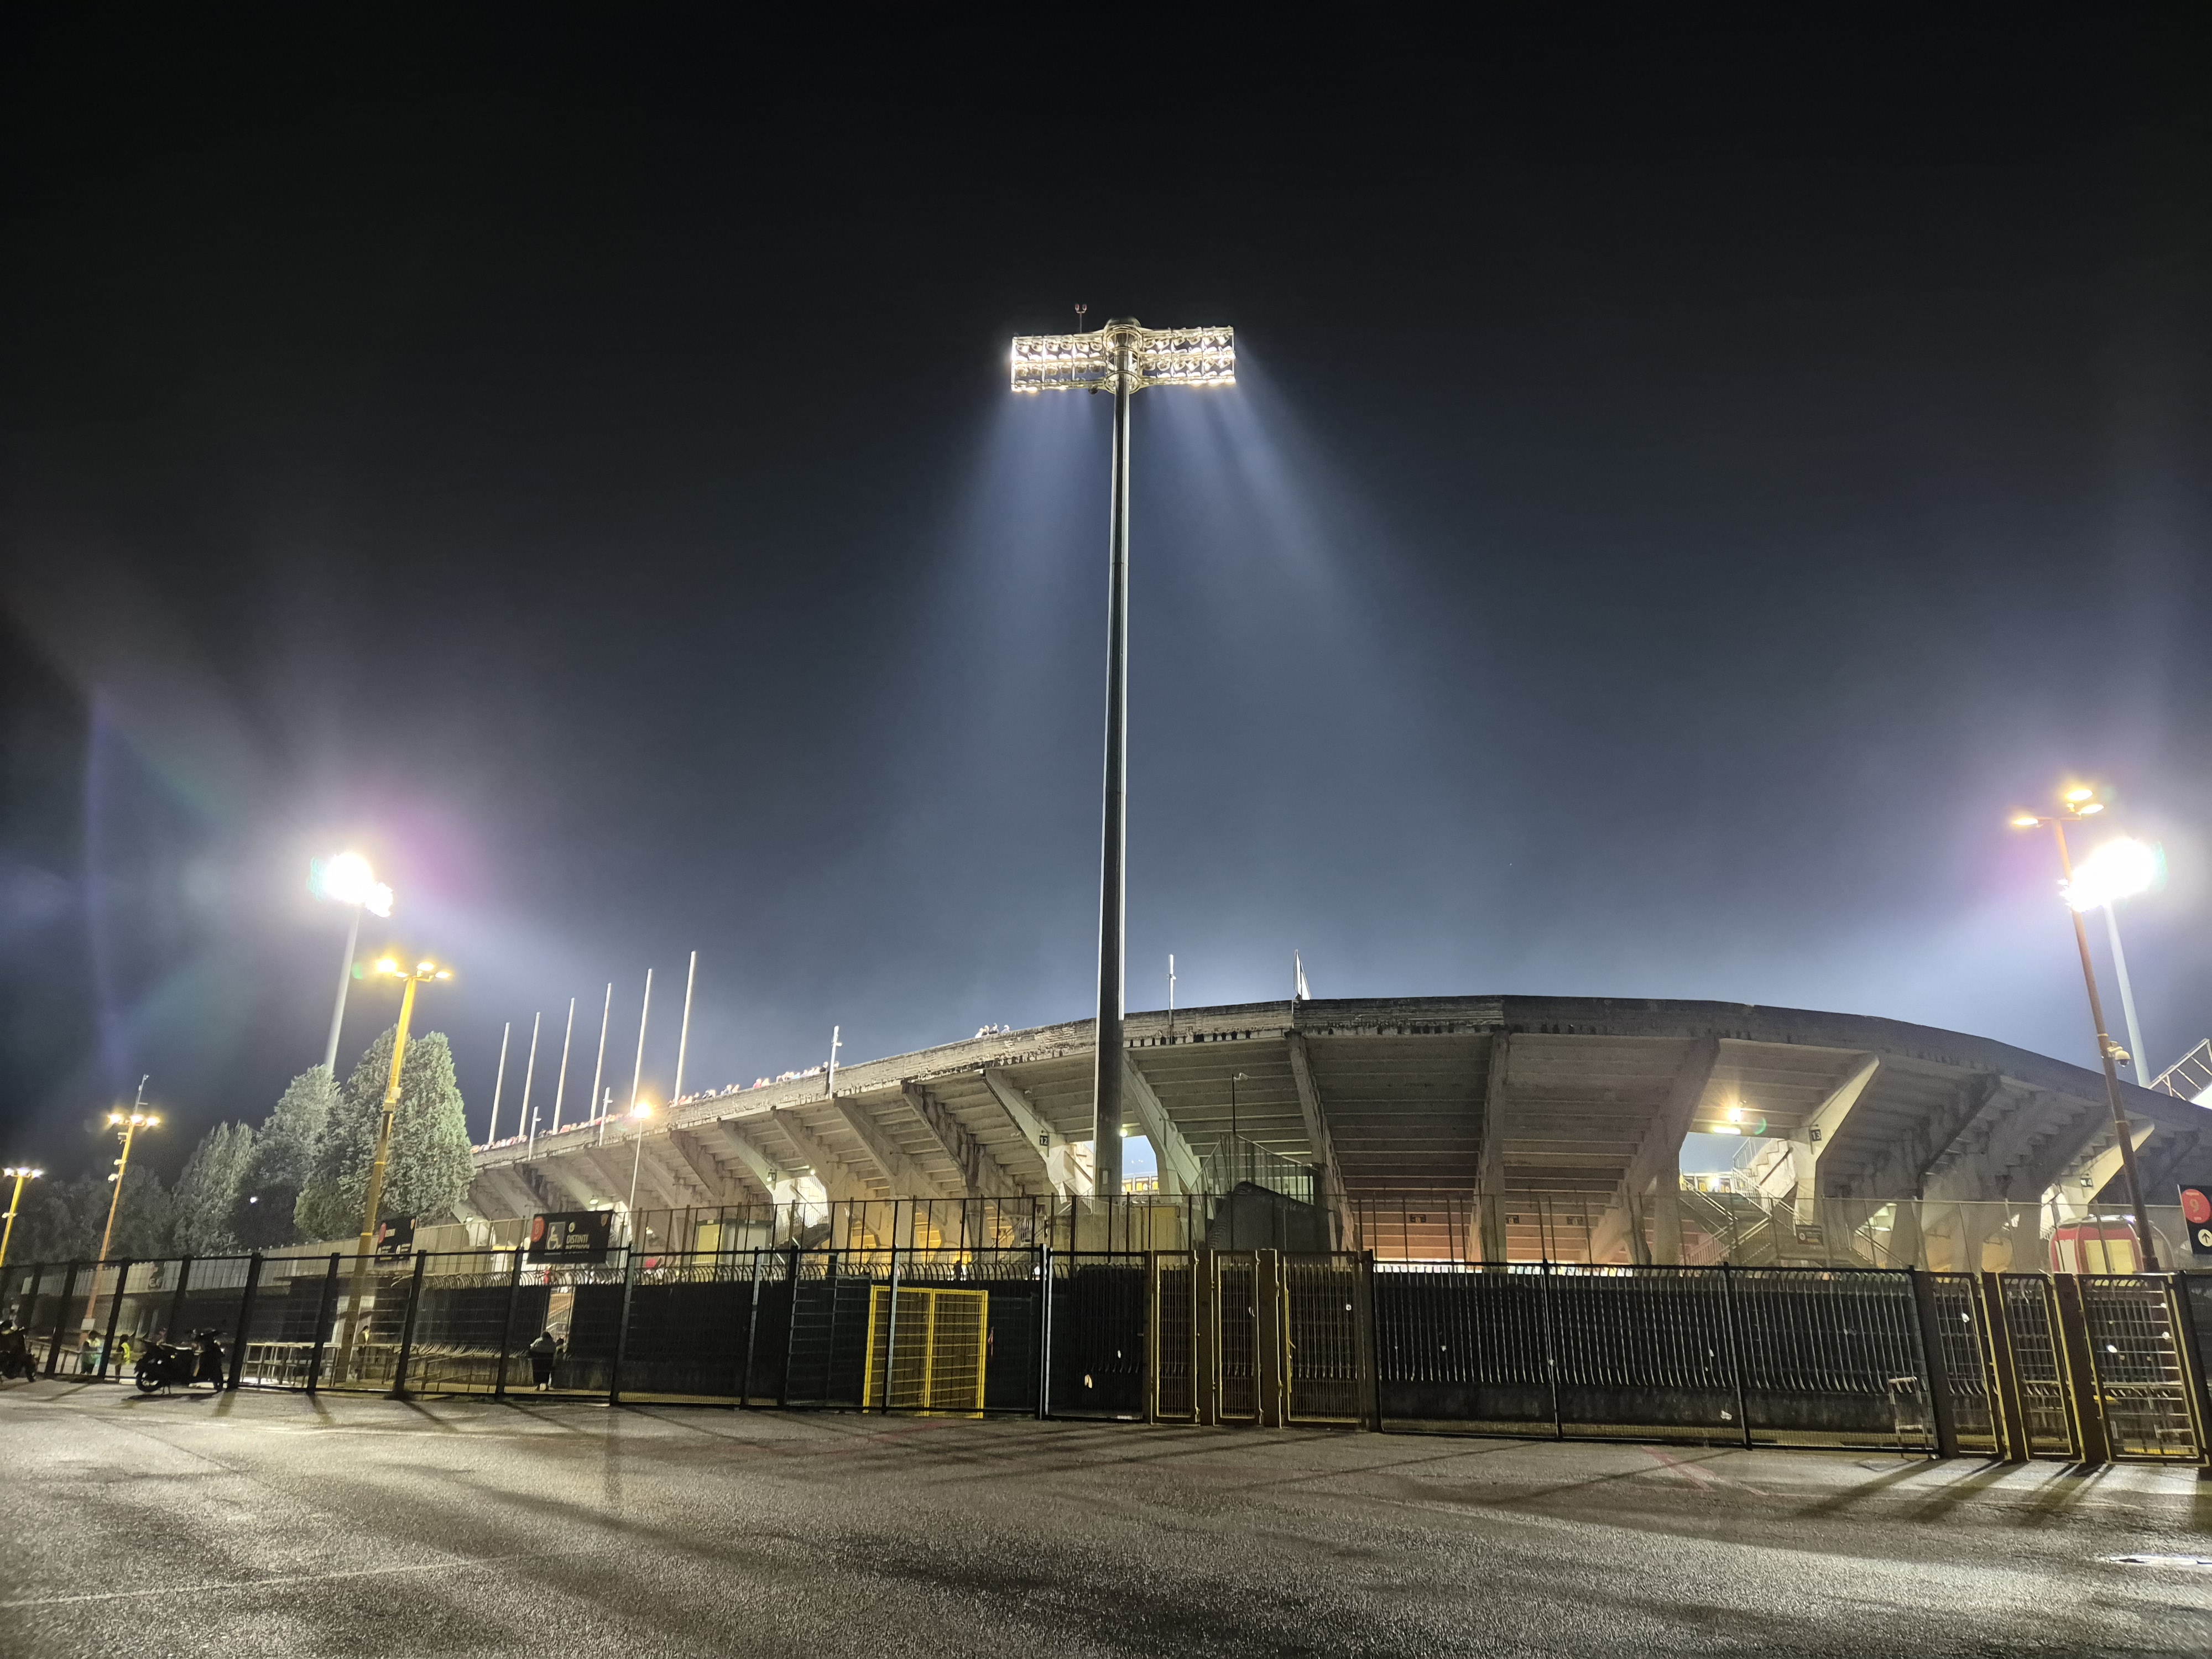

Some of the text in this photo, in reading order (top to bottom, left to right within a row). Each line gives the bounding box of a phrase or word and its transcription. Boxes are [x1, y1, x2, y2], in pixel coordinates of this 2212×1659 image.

[1812, 1131, 1821, 1140] 13
[2189, 1198, 2200, 1213] 9
[534, 1223, 540, 1234] 8
[566, 1234, 589, 1244] DISTINTI
